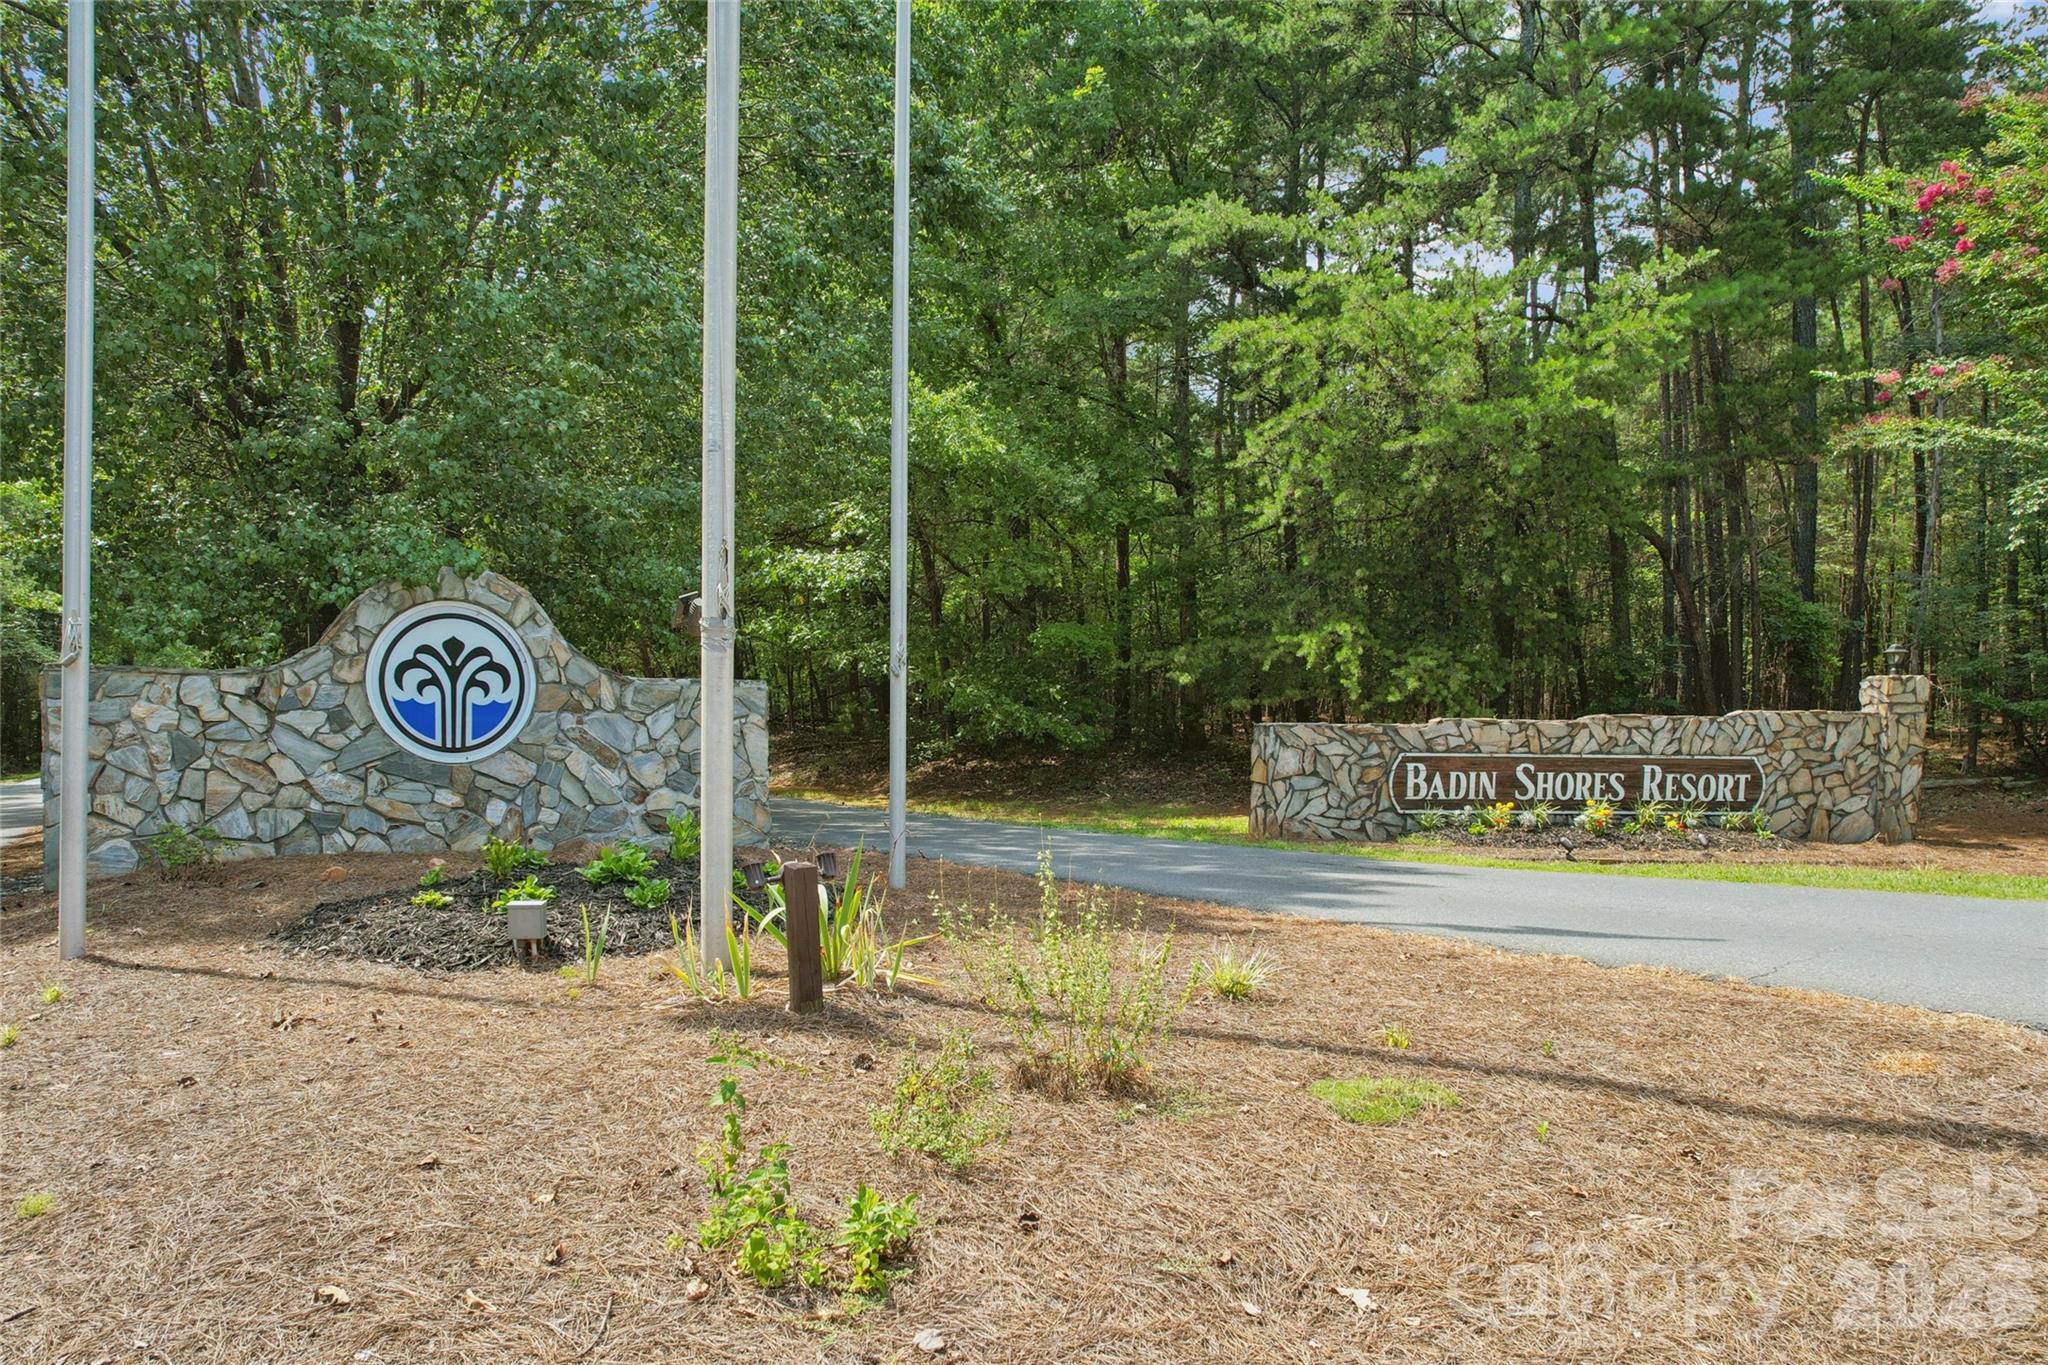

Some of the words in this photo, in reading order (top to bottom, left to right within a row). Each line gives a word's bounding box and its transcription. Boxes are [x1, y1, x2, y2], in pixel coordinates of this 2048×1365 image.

[1404, 762, 1498, 801] BADIN
[1515, 763, 1625, 801] SHORES
[1641, 764, 1751, 802] RESORT
